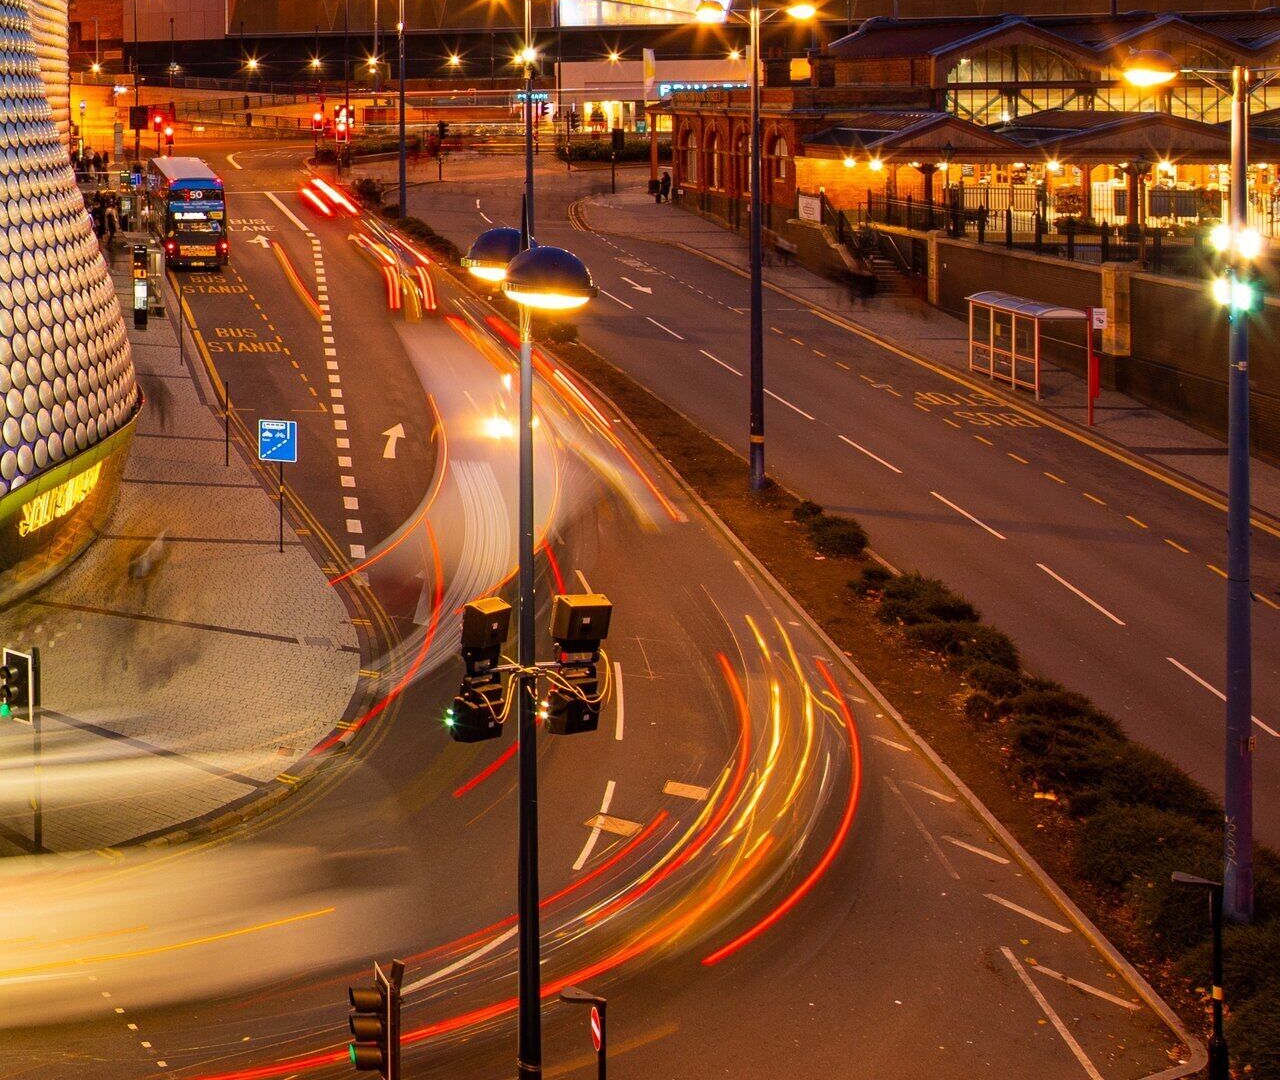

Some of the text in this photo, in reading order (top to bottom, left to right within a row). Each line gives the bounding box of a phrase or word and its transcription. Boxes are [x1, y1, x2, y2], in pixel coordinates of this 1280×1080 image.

[190, 275, 227, 283] BUS
[183, 285, 245, 294] STAND
[215, 327, 258, 338] BUS
[207, 341, 281, 353] STAND
[953, 411, 1041, 427] BUS
